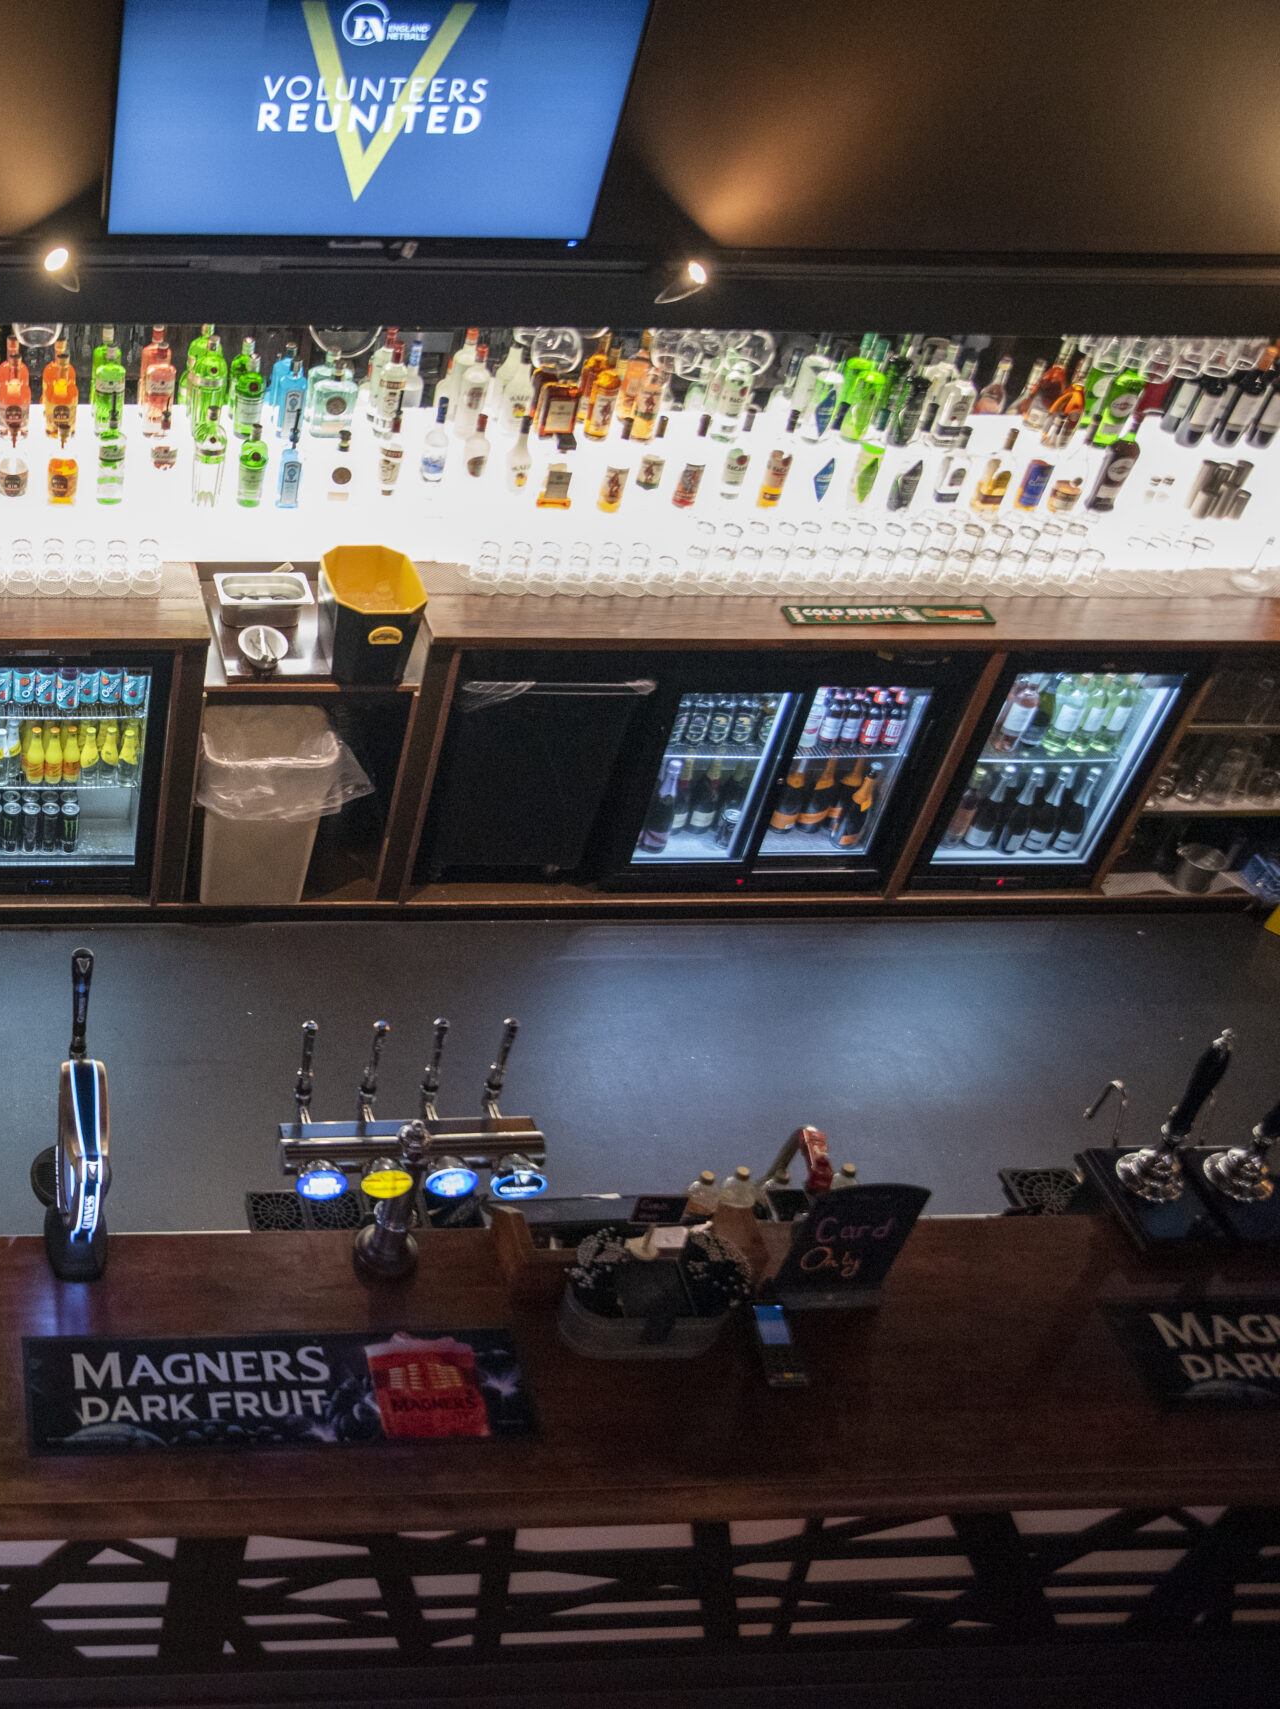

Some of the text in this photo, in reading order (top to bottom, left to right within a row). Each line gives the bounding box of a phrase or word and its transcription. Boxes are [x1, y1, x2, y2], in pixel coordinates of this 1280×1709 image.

[386, 32, 429, 41] NETBALL
[388, 23, 431, 32] ENGLAND
[263, 75, 489, 104] VOLUNTEERS
[256, 102, 483, 135] REUNITED
[802, 608, 844, 616] COLD
[57, 684, 74, 702] Oasis
[101, 678, 121, 697] Oasis
[815, 1214, 893, 1244] Card
[800, 1246, 861, 1278] Only
[71, 1346, 331, 1390] MAGNERS
[80, 1390, 327, 1425] DARK FRUIT
[389, 1395, 478, 1412] MAGNERS
